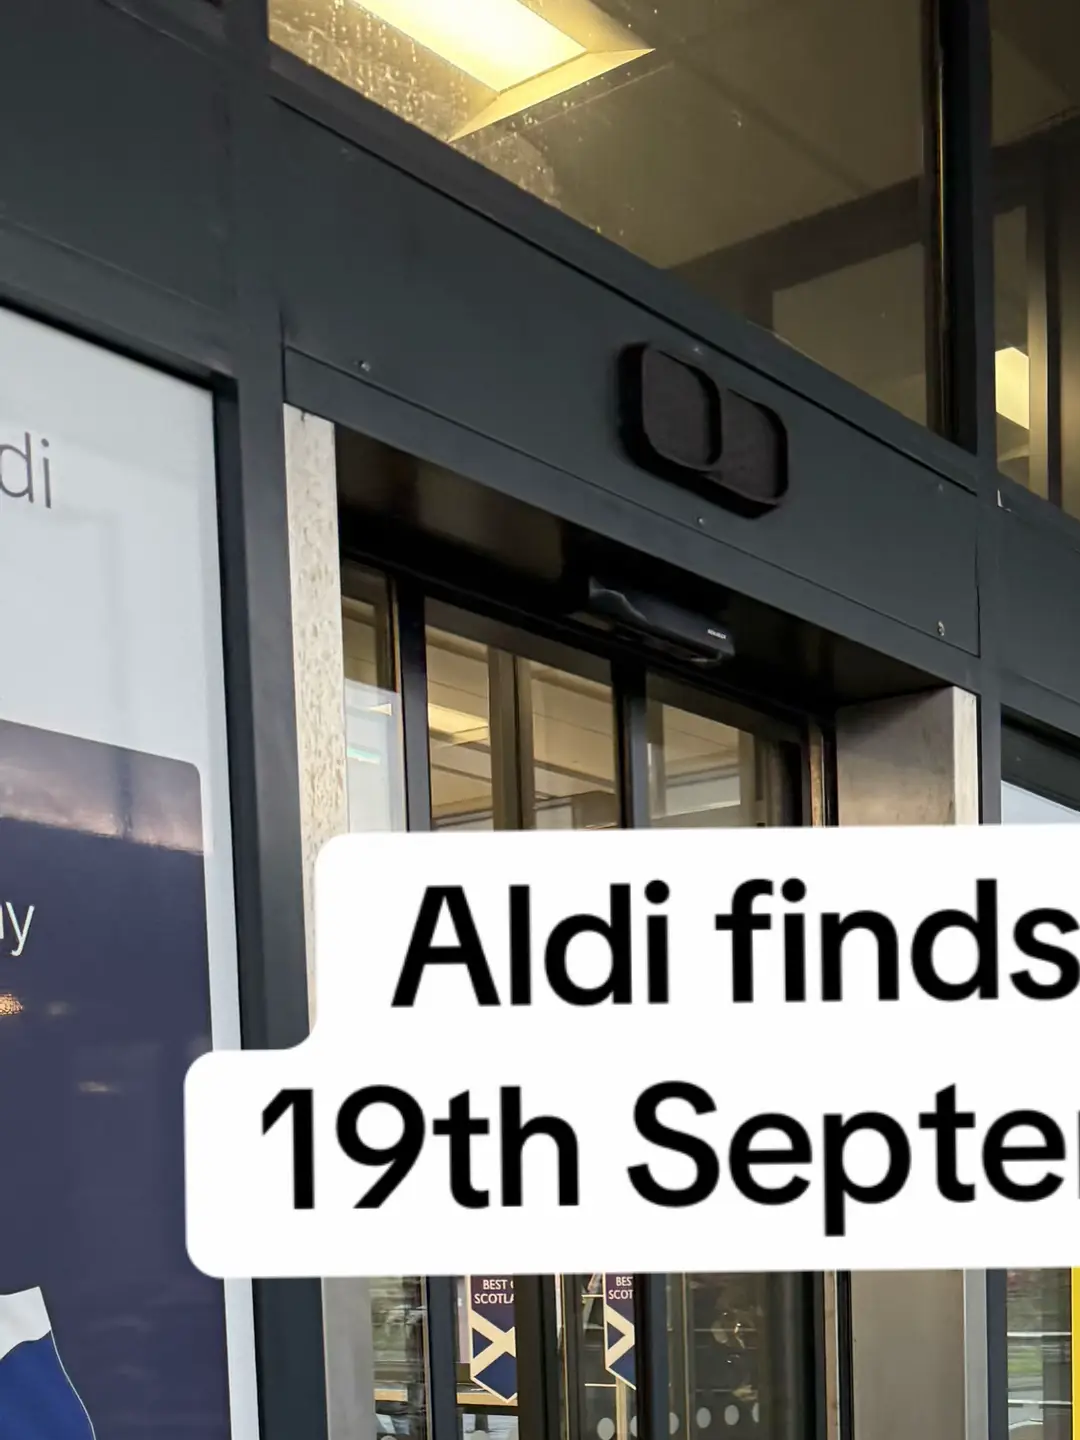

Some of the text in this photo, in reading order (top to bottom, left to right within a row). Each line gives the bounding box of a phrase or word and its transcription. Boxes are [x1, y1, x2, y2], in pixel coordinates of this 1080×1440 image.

[0, 901, 35, 957] y
[482, 1279, 508, 1290] BEST
[615, 1276, 633, 1287] BES
